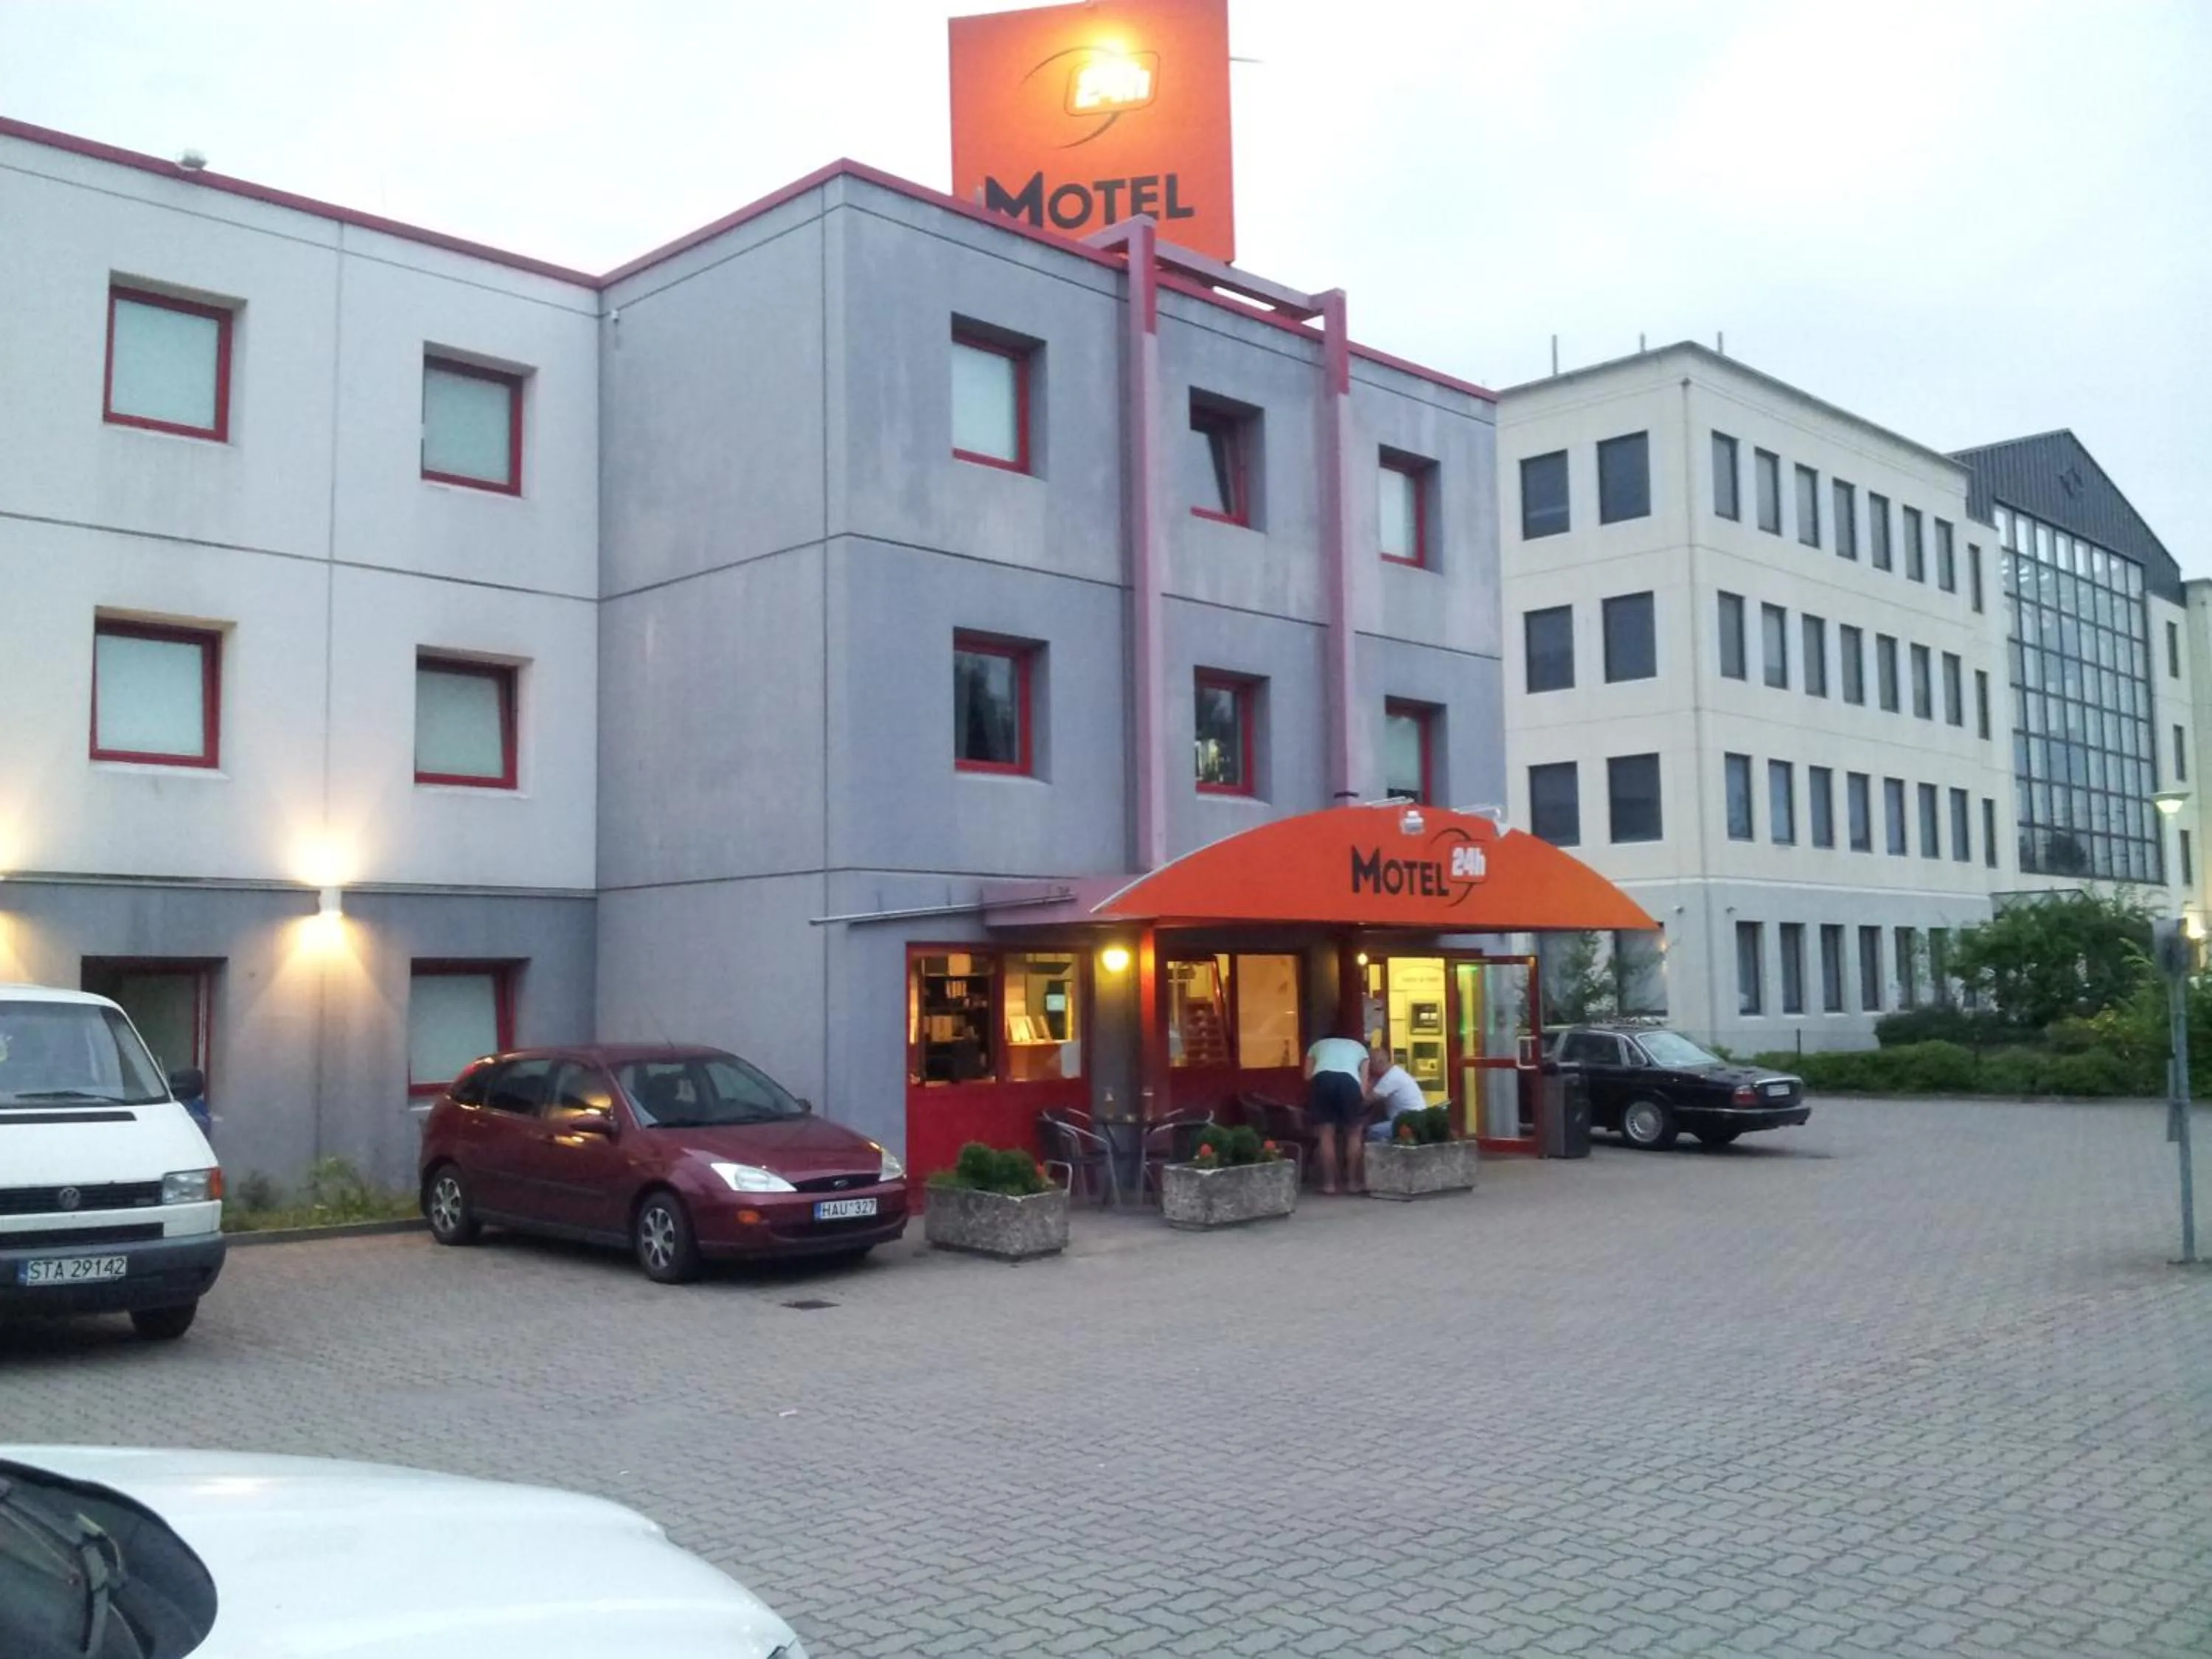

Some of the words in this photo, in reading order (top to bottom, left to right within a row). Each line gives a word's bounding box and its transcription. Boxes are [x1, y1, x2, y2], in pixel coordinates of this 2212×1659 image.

[985, 170, 1194, 229] MOTEL
[1351, 844, 1450, 897] MOTEL
[1452, 847, 1486, 877] 24h
[822, 1203, 848, 1216] HAU
[855, 1200, 874, 1215] 327
[29, 1260, 64, 1279] STA
[71, 1258, 126, 1278] 29142
